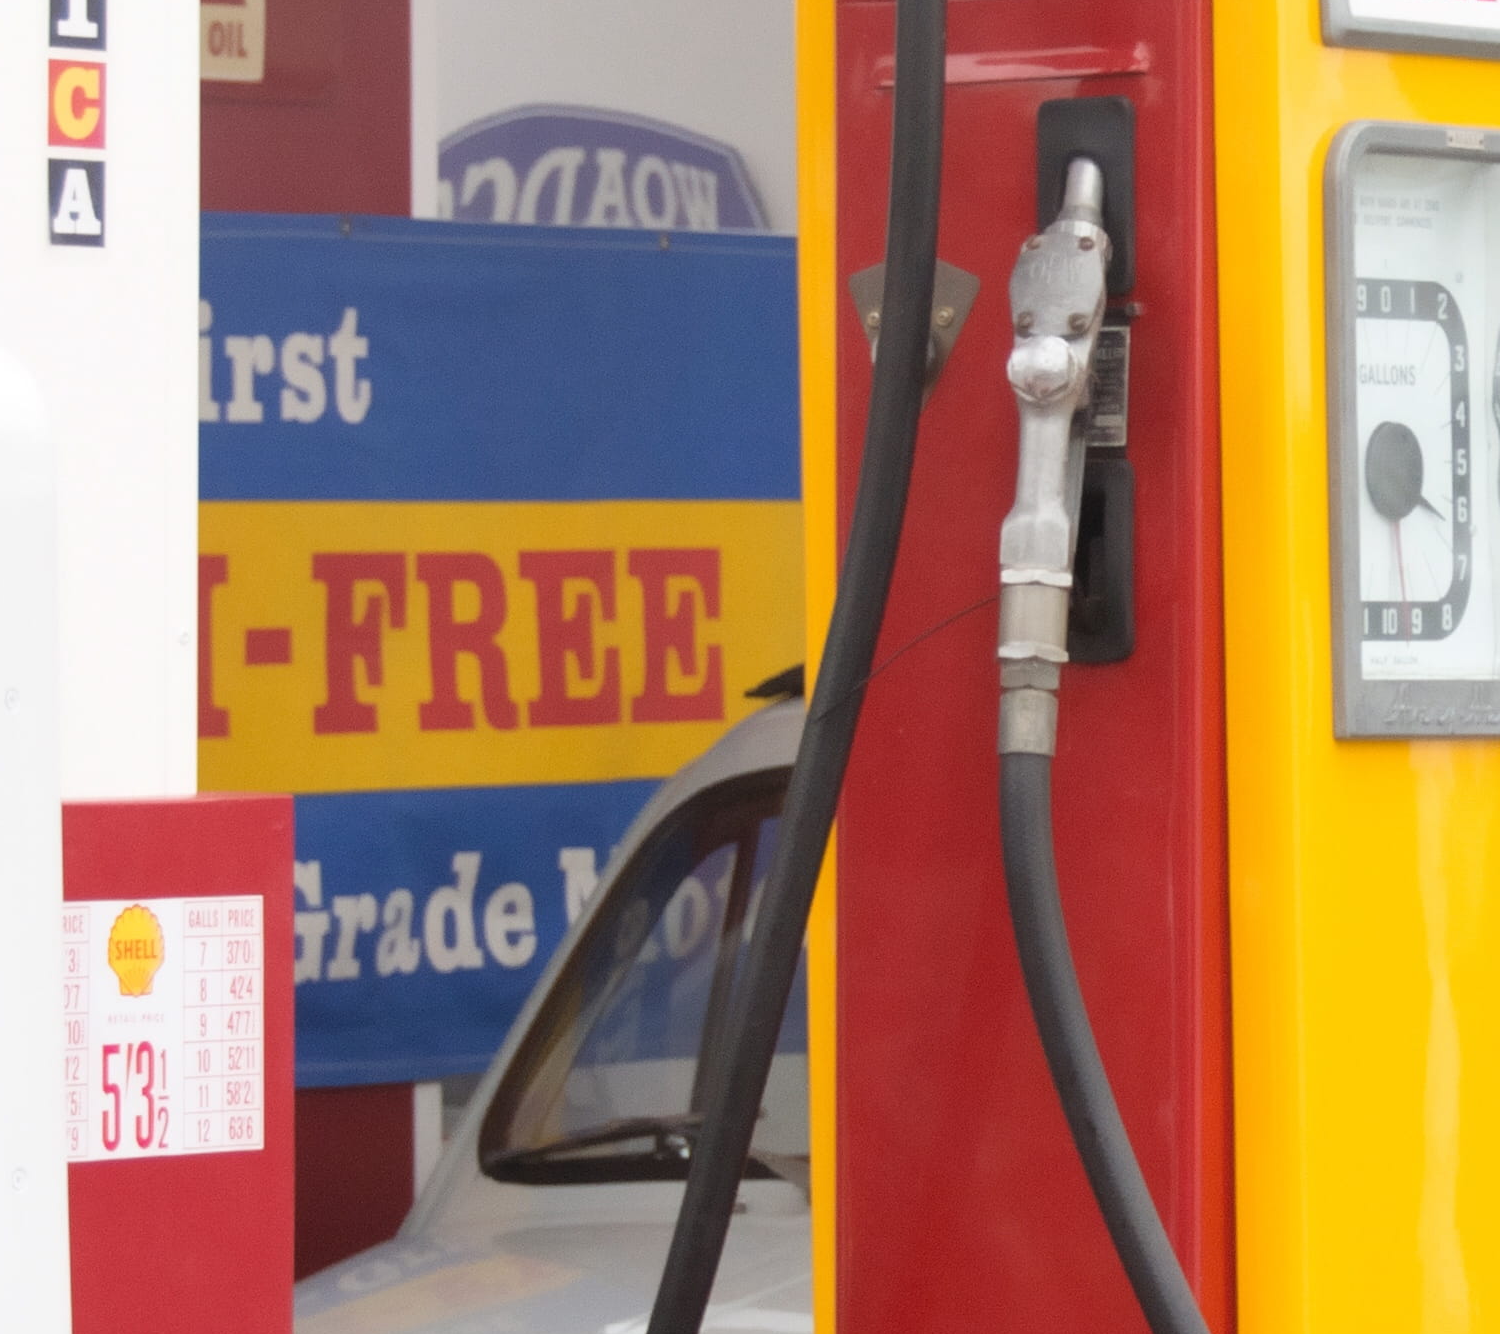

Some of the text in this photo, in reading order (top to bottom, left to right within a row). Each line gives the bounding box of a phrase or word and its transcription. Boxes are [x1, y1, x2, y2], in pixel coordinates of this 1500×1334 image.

[208, 19, 248, 58] OIL
[1437, 292, 1448, 320] 2
[198, 298, 372, 424] irst
[1359, 363, 1417, 387] GALLONS
[1455, 400, 1466, 428] 4
[1456, 449, 1468, 476] 5
[1457, 496, 1468, 523] 6
[1457, 555, 1468, 581] 7
[1382, 607, 1398, 635] 10
[1411, 607, 1423, 634] 9
[63, 915, 84, 934] RICE
[189, 907, 255, 929] GALLS PRICE
[115, 938, 158, 961] SHELL
[200, 942, 207, 966] 7
[200, 978, 207, 1002] 8
[200, 1013, 207, 1037] 9
[197, 1049, 211, 1073] 10
[199, 1084, 210, 1108] 11
[197, 1119, 211, 1143] 12
